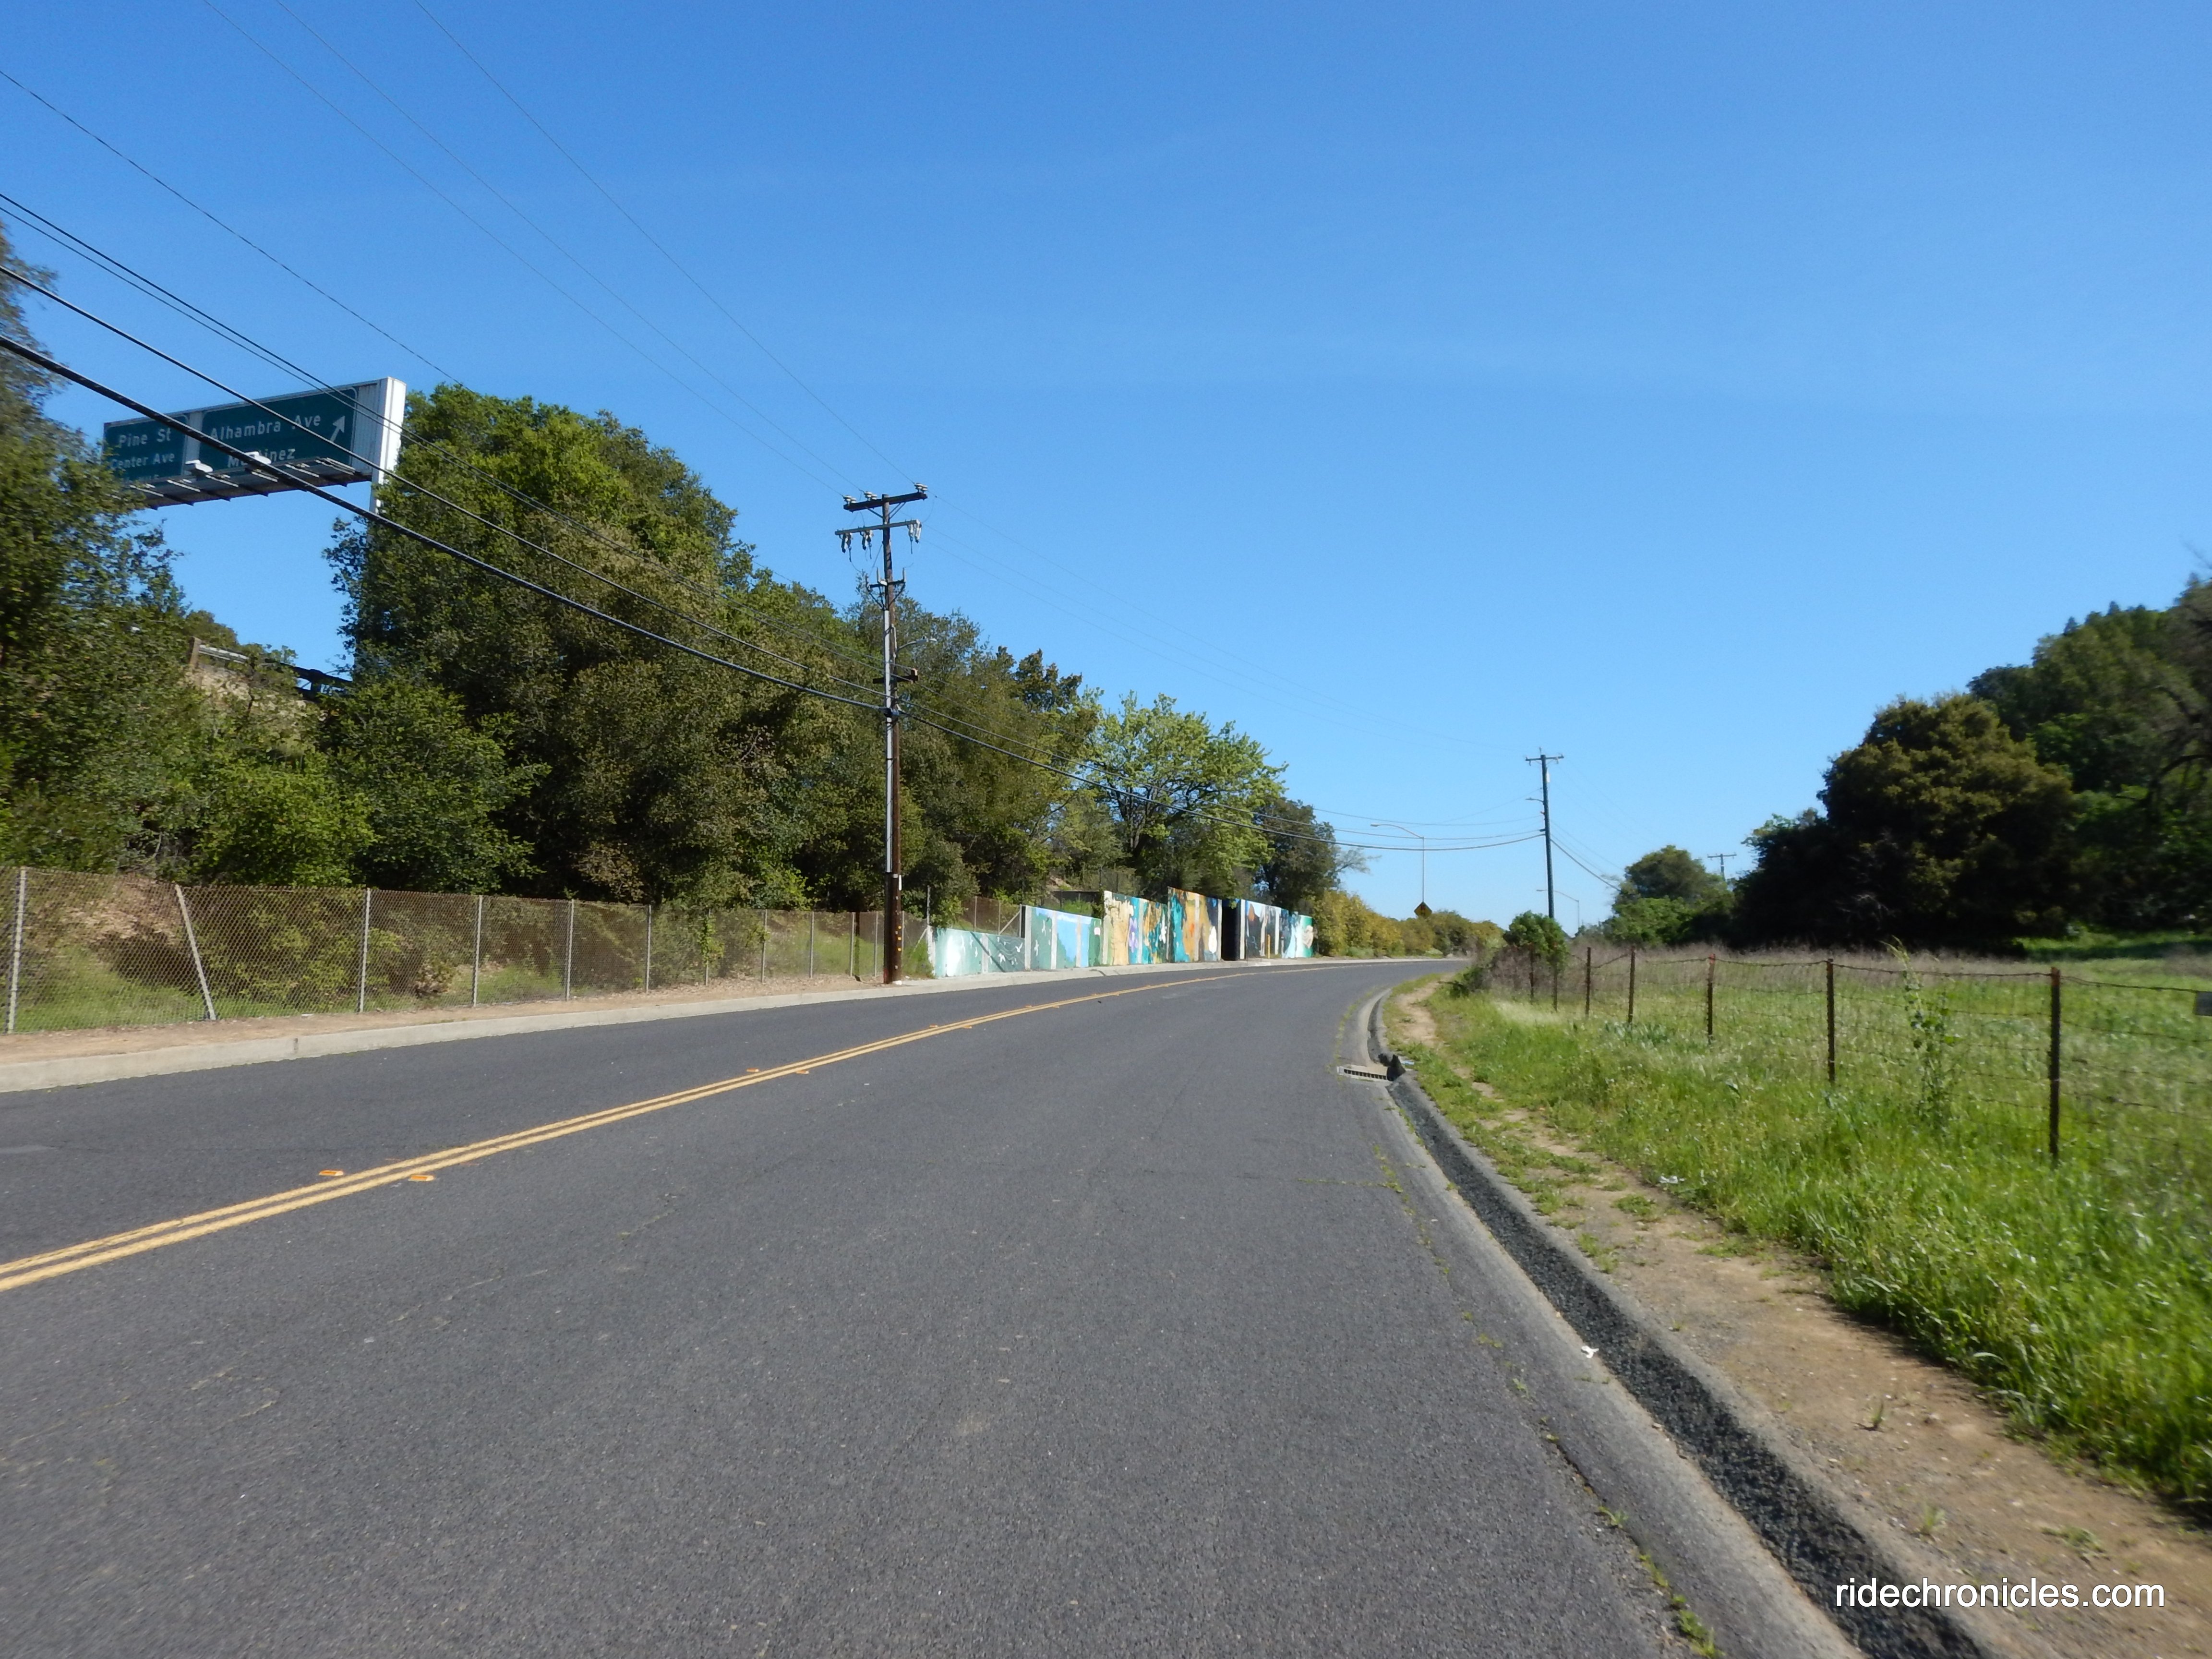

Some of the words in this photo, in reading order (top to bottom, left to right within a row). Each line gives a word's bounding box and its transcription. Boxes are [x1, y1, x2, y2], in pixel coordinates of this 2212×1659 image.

[210, 421, 281, 440] Alhambra
[292, 415, 321, 430] Ave
[119, 433, 148, 448] Pine
[156, 428, 171, 443] St
[110, 457, 149, 470] Center
[153, 453, 175, 465] Ave
[228, 448, 296, 468] Minez
